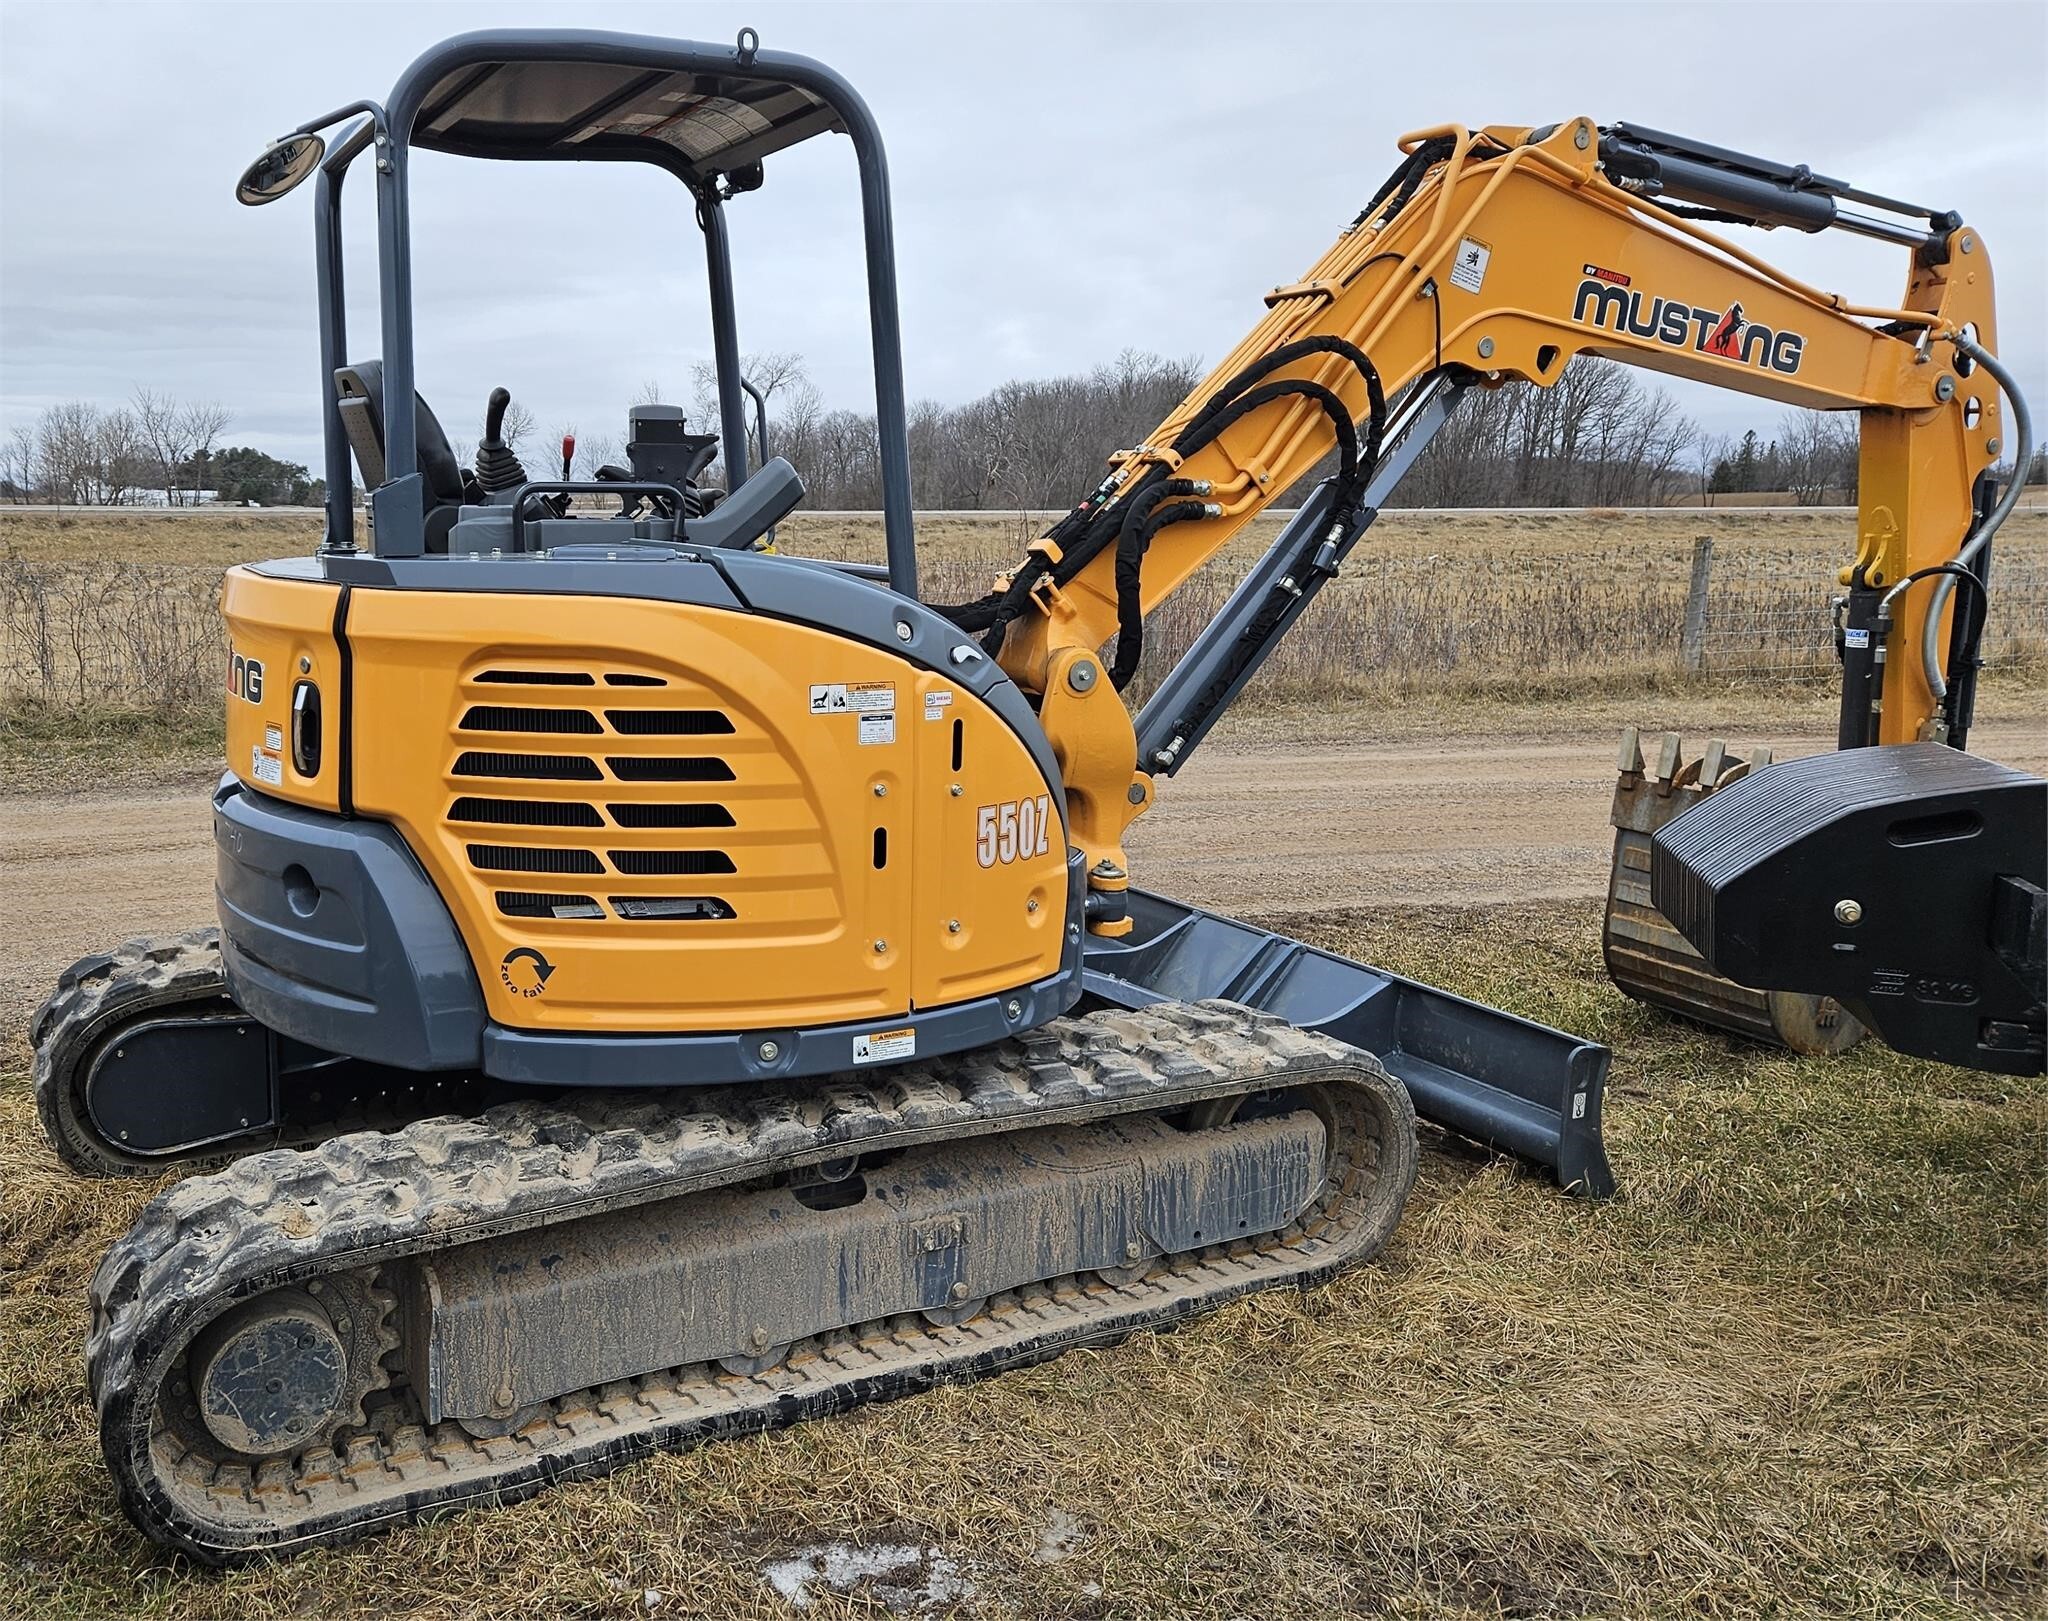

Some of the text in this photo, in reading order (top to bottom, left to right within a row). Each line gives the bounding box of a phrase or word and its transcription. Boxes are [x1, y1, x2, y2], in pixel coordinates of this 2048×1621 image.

[1585, 266, 1629, 285] BY MANITOU
[1573, 279, 1804, 375] MUSTANG
[976, 794, 1050, 869] 550Z
[501, 965, 546, 998] zero tail
[883, 1031, 907, 1039] WARNING
